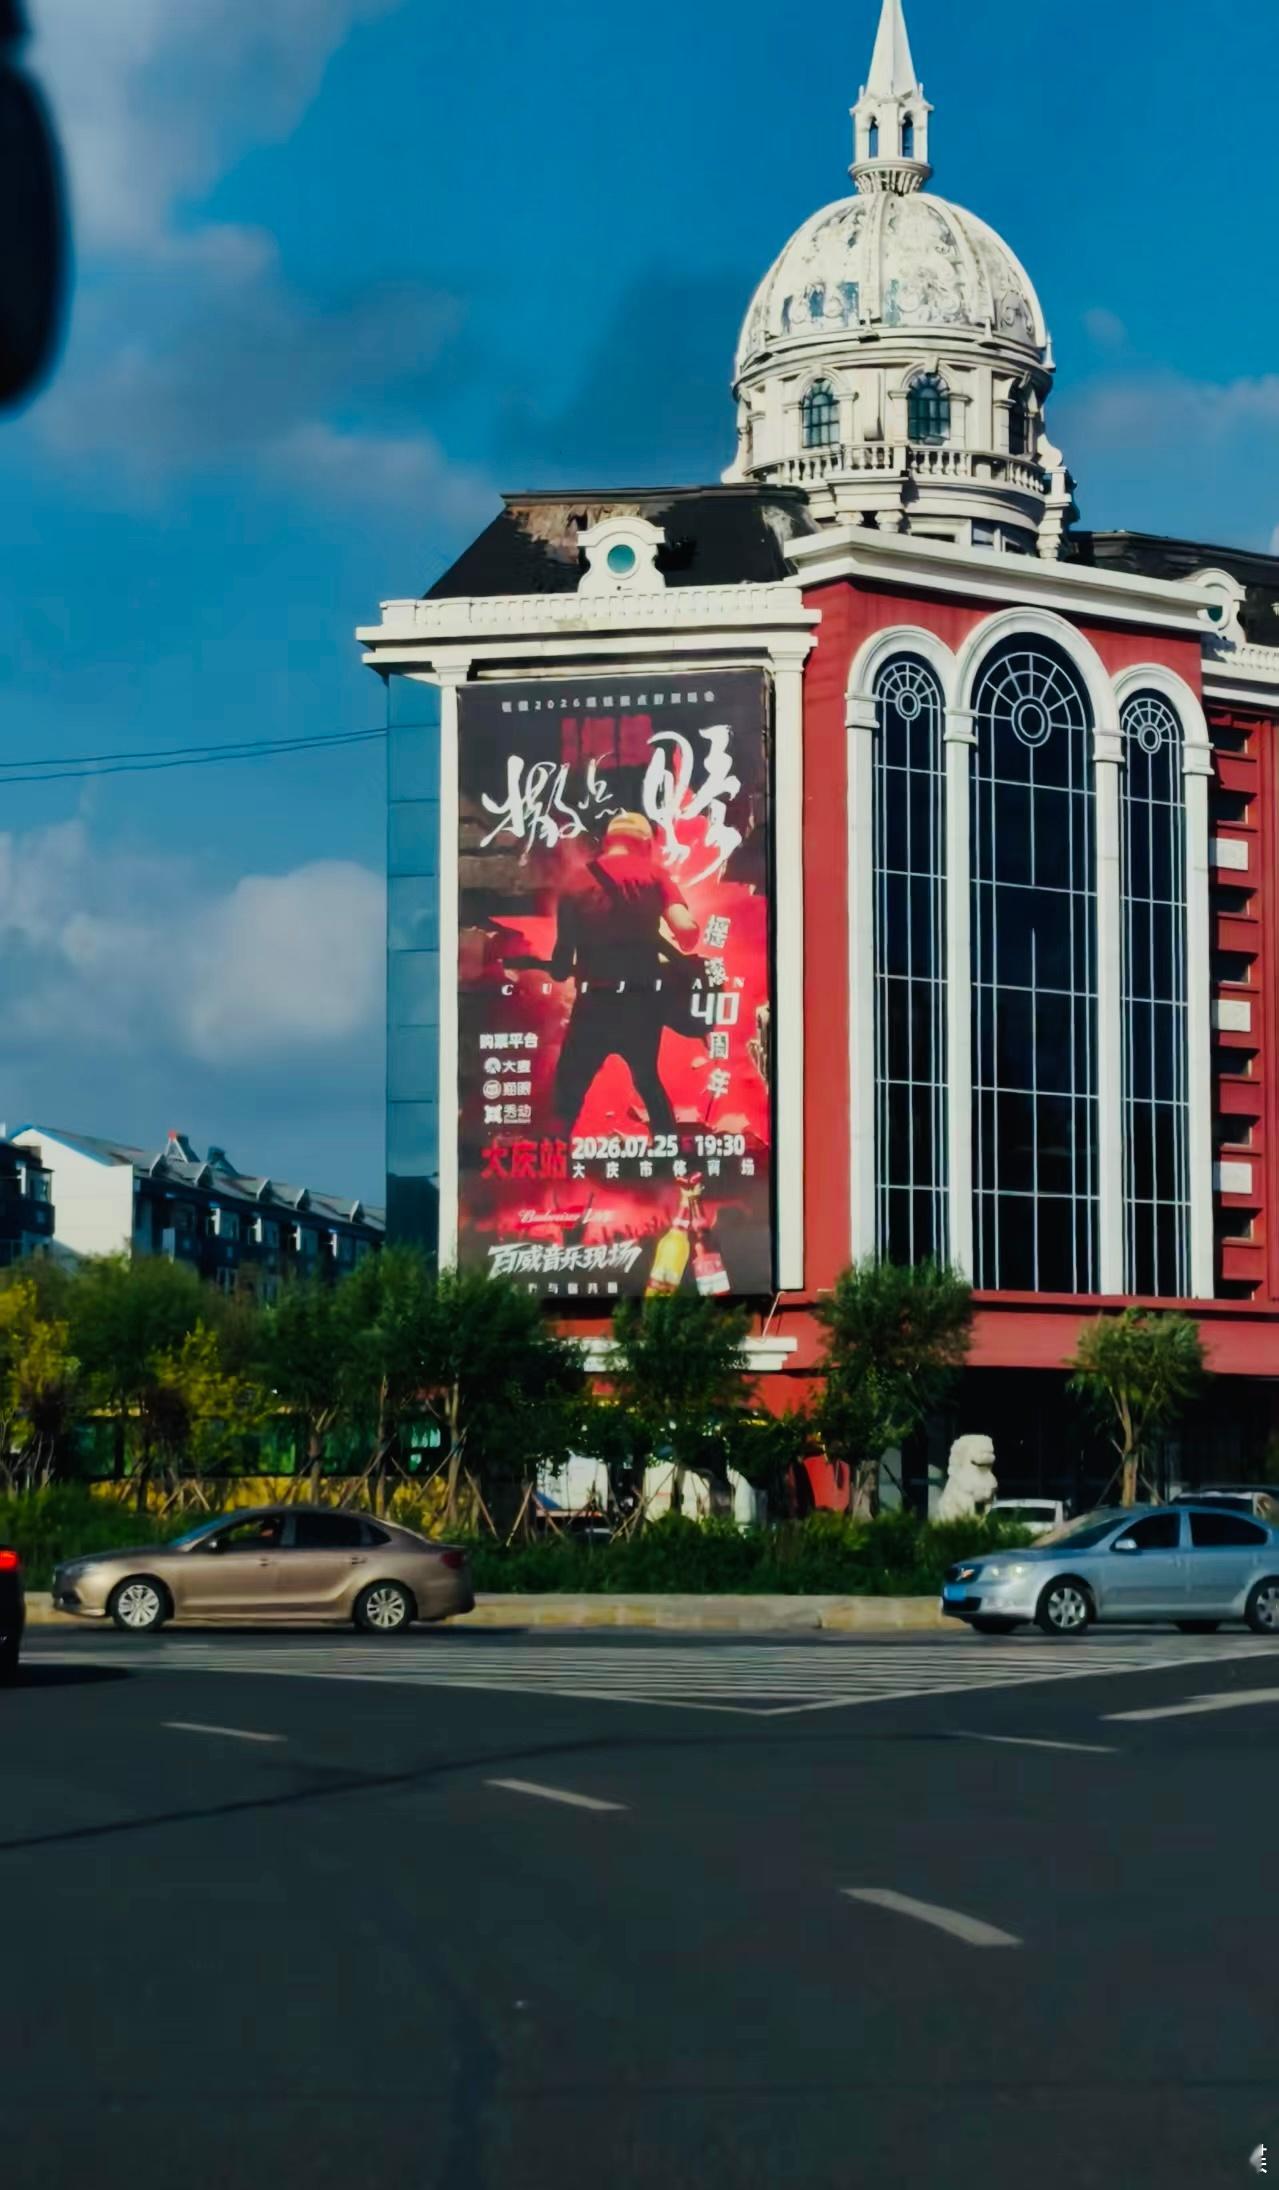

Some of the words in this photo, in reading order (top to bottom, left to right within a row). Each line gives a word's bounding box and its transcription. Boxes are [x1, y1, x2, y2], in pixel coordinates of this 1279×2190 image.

[480, 1138, 567, 1179] 大庆站
[571, 1135, 679, 1160] 2026.07.25
[694, 1134, 746, 1157] 19:30
[487, 1238, 643, 1281] 百威音乐现场
